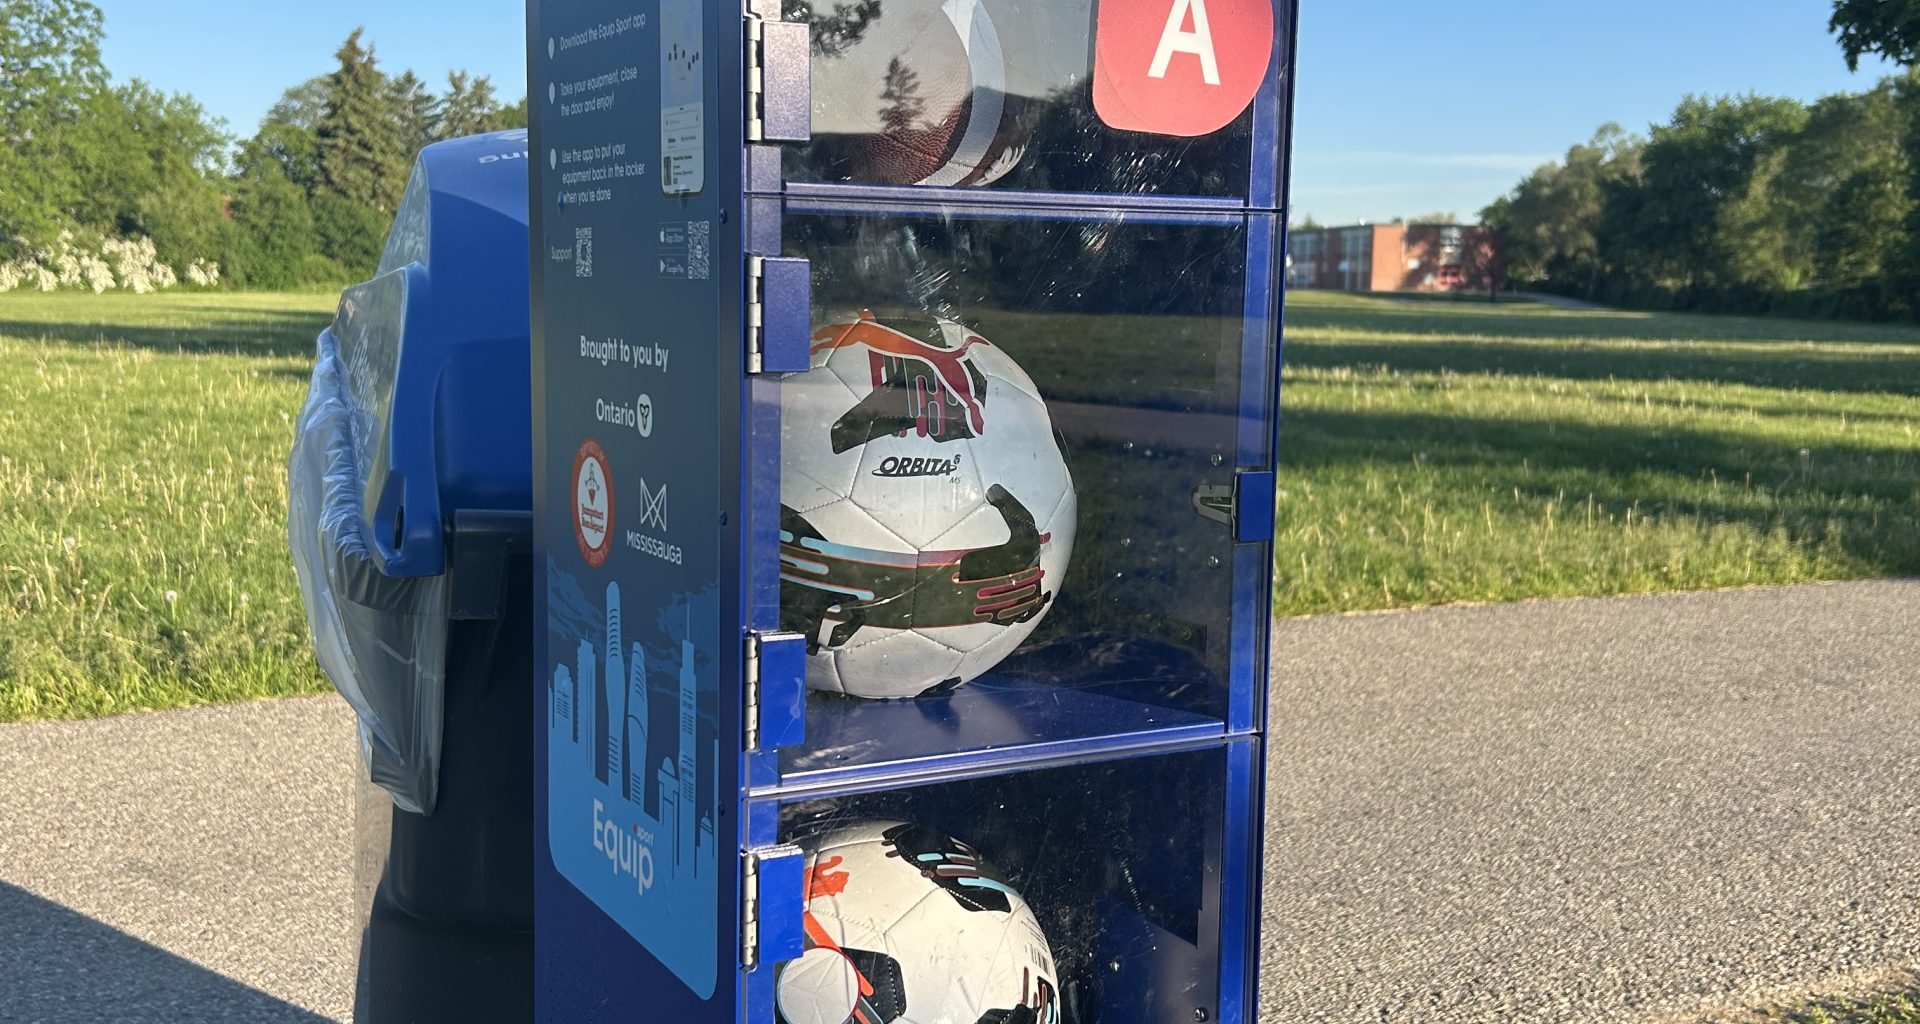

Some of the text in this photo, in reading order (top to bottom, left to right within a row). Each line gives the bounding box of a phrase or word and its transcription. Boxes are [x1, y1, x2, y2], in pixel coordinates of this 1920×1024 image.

[560, 13, 646, 50] Download the Equip Sport app
[1147, 0, 1220, 86] A
[561, 82, 574, 96] Take
[574, 80, 587, 96] your
[621, 66, 638, 82] close
[561, 91, 615, 116] the door and enjoy!
[562, 142, 626, 163] Use the app to put your
[562, 161, 645, 187] equipment back in the locker
[563, 190, 577, 204] when
[596, 187, 611, 201] done
[551, 246, 572, 263] Support
[580, 335, 669, 372] Brought to you by
[596, 398, 635, 427] Ontario
[593, 797, 654, 896] Equip
